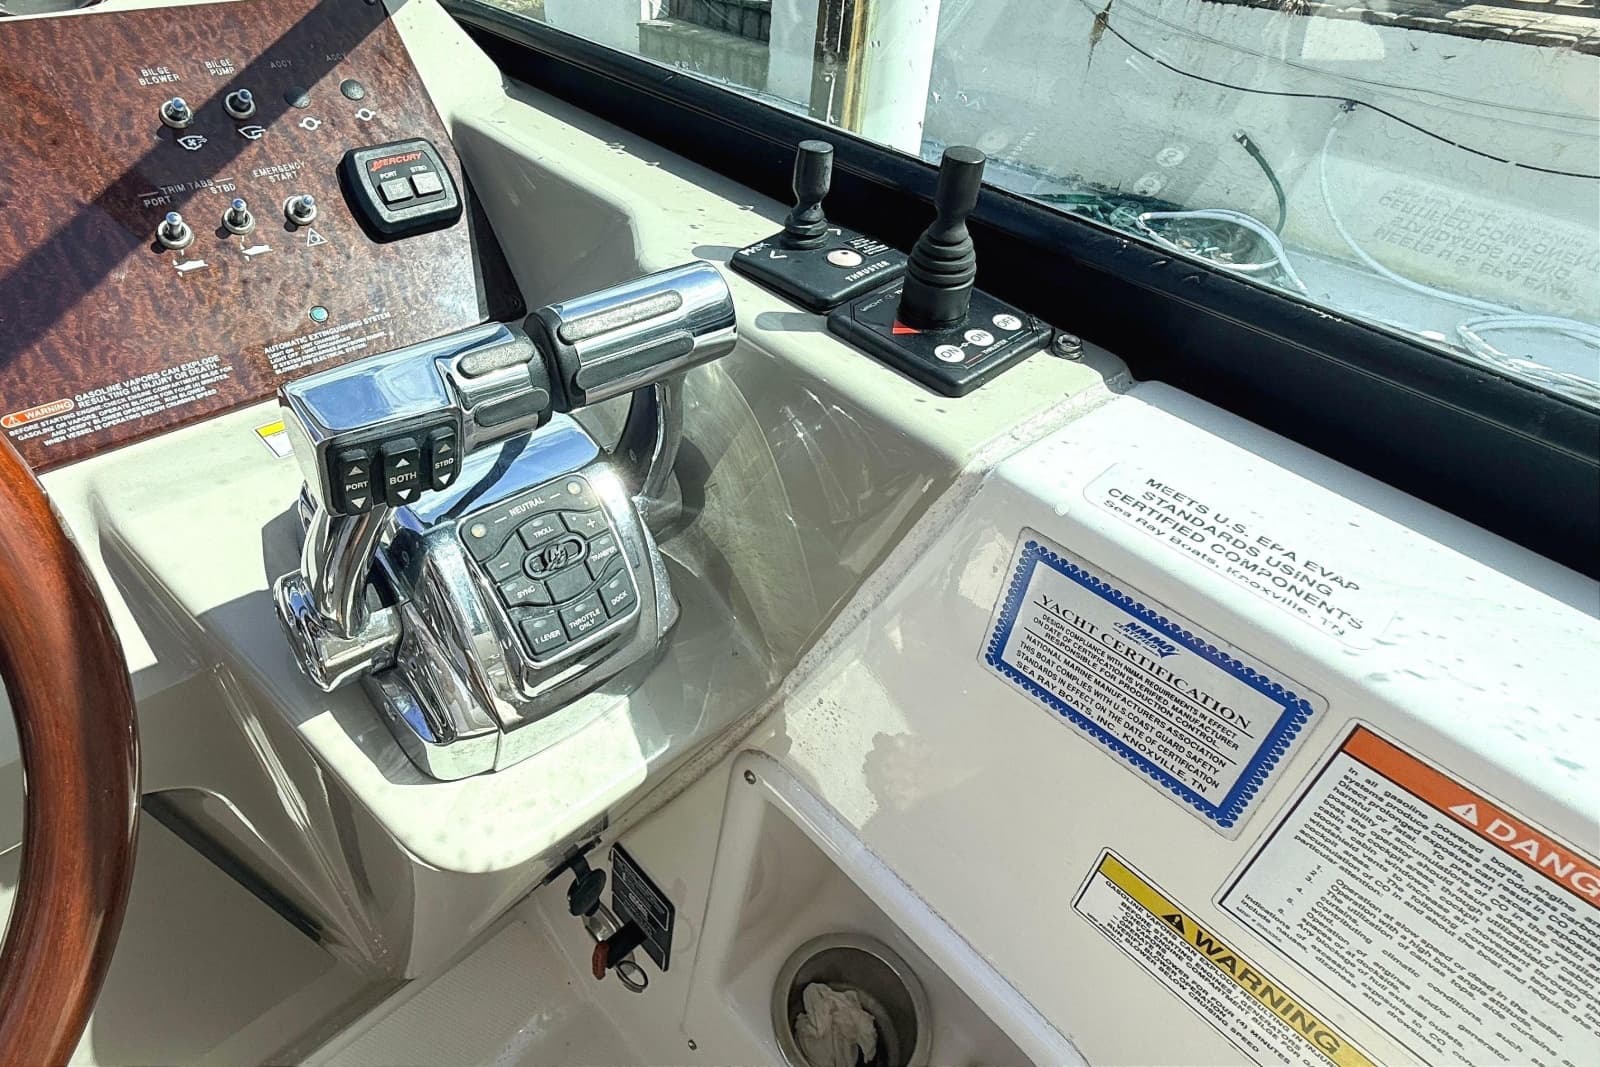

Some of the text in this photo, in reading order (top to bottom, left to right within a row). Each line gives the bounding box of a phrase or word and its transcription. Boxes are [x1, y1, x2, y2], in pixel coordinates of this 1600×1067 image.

[140, 66, 170, 77] BILGE
[204, 58, 233, 69] BILGE
[209, 66, 235, 77] PUMP
[138, 74, 181, 86] BLOWER
[253, 160, 306, 178] EMERGENCY
[371, 152, 422, 172] MERCURY
[160, 178, 215, 196] TRIM TABS
[209, 183, 236, 195] STBD
[268, 171, 298, 184] START
[143, 196, 172, 208] PORT
[844, 260, 891, 282] THRUSTER
[970, 331, 990, 342] ON
[996, 316, 1016, 327] OFF
[940, 347, 960, 359] ON
[74, 354, 220, 401] GASOLINE VAPORS CAN EXPLODE
[77, 362, 219, 408] RESULTING IN INJURY OR DEATH.
[24, 401, 72, 420] WARNING
[389, 471, 417, 485] BOTH
[434, 457, 454, 469] STBD
[345, 480, 369, 492] PORT
[508, 497, 545, 517] NEUTRAL
[1103, 499, 1131, 517] Sea
[1135, 517, 1165, 535] Ray
[532, 526, 554, 539] TROLL
[1141, 491, 1332, 596] STANDARDS USING
[1145, 478, 1359, 590] MEETS U.S. EPA EVAP
[1108, 488, 1362, 629] CERTIFIED COMPONENTS
[517, 585, 536, 599] SYNC
[611, 590, 628, 606] DOCK
[568, 609, 600, 629] THROTTLE
[579, 618, 595, 632] ONLY
[540, 629, 561, 643] LEVER
[1125, 622, 1176, 652] NMMA
[1042, 594, 1098, 634] YACHT
[1100, 633, 1250, 729] CERTIFICATION
[1042, 614, 1065, 631] DESIGN
[1065, 628, 1105, 657] COMPLIANCE
[1106, 654, 1123, 668] WITH
[1123, 664, 1143, 681] NMMA
[1144, 677, 1198, 715] REQUIREMENTS
[1198, 712, 1207, 720] IN
[1207, 717, 1237, 738] EFFECT
[1044, 632, 1098, 669] RESPONSIBLE
[1099, 667, 1116, 681] FOR
[1118, 679, 1173, 717] PRODUCTION
[1033, 616, 1043, 626] ON
[1043, 623, 1061, 638] DATE
[1062, 635, 1072, 643] OF
[1072, 641, 1125, 678] CERTIFICATION
[1125, 675, 1133, 683] IS
[1170, 704, 1238, 750] MANUFACTURER
[1020, 640, 1035, 655] THIS
[1035, 651, 1055, 667] BOAT
[1055, 664, 1092, 692] COMPLIES
[1093, 688, 1112, 705] WITH
[1155, 730, 1185, 753] GUARD
[1185, 750, 1219, 775] SAFETY
[1026, 633, 1226, 767] NATIONAL MARINE MANUFACTURERS ASSOCIATION
[1015, 660, 1034, 677] SEA
[1036, 674, 1057, 690] RAY
[1057, 688, 1093, 718] BOATS,
[1122, 732, 1186, 781] KNOXVILLE,
[1191, 777, 1206, 792] TN
[1016, 649, 1219, 788] STANDARDS IN EFFECT ON THE DATE OF CERTIFICATION
[1343, 774, 1558, 912] systems produce colorless and odorless
[1348, 767, 1576, 912] In all gasoline powered boats, engine
[1485, 818, 1600, 898] DANG
[1121, 915, 1133, 926] OR
[1136, 926, 1166, 954] VAPORS
[1105, 880, 1143, 913] GASOLINE
[1145, 912, 1177, 940] VAPORS
[1179, 940, 1197, 956] CAN
[1198, 956, 1237, 989] EXPLODE
[1239, 990, 1289, 1032] RESULTING
[1291, 1033, 1302, 1042] IN
[1304, 1043, 1336, 1067] INJUR
[1116, 923, 1143, 946] VERIFY
[1143, 947, 1177, 976] BLOWER
[1178, 976, 1226, 1017] OPERATION
[1120, 901, 1151, 928] BEFORE
[1153, 928, 1193, 962] STARTING
[1194, 962, 1232, 994] ENGINES
[1240, 1000, 1301, 1050] GENERATORS
[1124, 911, 1152, 935] CHECK
[1153, 934, 1184, 961] ENGINE
[1185, 961, 1249, 1014] COMPARTMENT
[1251, 1016, 1278, 1040] BILGE
[1280, 1040, 1300, 1058] FOR
[1106, 922, 1123, 937] RUN
[1124, 937, 1156, 966] BLOWER
[1157, 966, 1187, 990] BELOW
[1188, 991, 1228, 1026] CRUISING
[1230, 1027, 1259, 1052] SPEED
[1119, 920, 1154, 950] OPERATE
[1155, 950, 1189, 979] BLOWER
[1191, 980, 1208, 996] FOR
[1210, 996, 1234, 1017] FOUR
[1235, 1018, 1247, 1029] (4)
[1250, 1029, 1290, 1064] MINUTES
[1195, 929, 1341, 1055] WARNING
